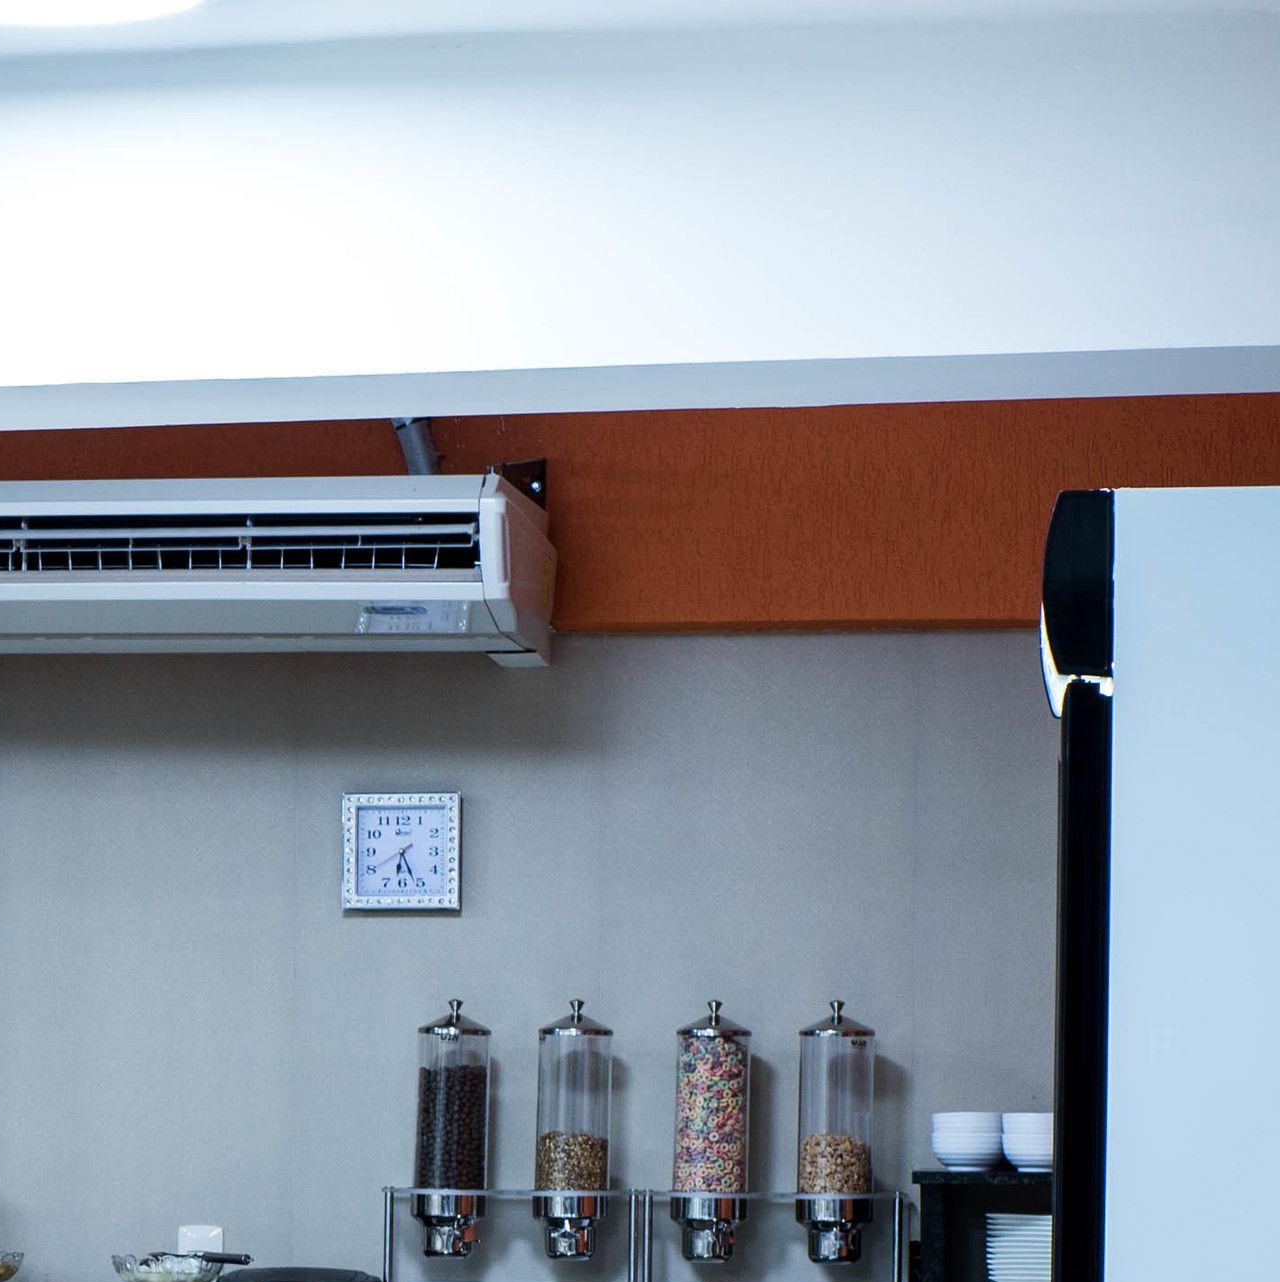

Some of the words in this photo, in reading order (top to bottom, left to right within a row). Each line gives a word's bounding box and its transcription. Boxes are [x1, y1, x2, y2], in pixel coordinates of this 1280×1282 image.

[379, 816, 389, 825] 11
[396, 816, 411, 825] 12
[418, 816, 422, 825] 1
[367, 830, 382, 839] 10
[429, 828, 439, 838] 2
[366, 847, 376, 857] 9
[429, 847, 439, 857] 3
[366, 865, 377, 875] 8
[429, 865, 438, 875] 4
[382, 878, 391, 888] 7
[397, 878, 407, 888] 6
[415, 878, 426, 888] 5
